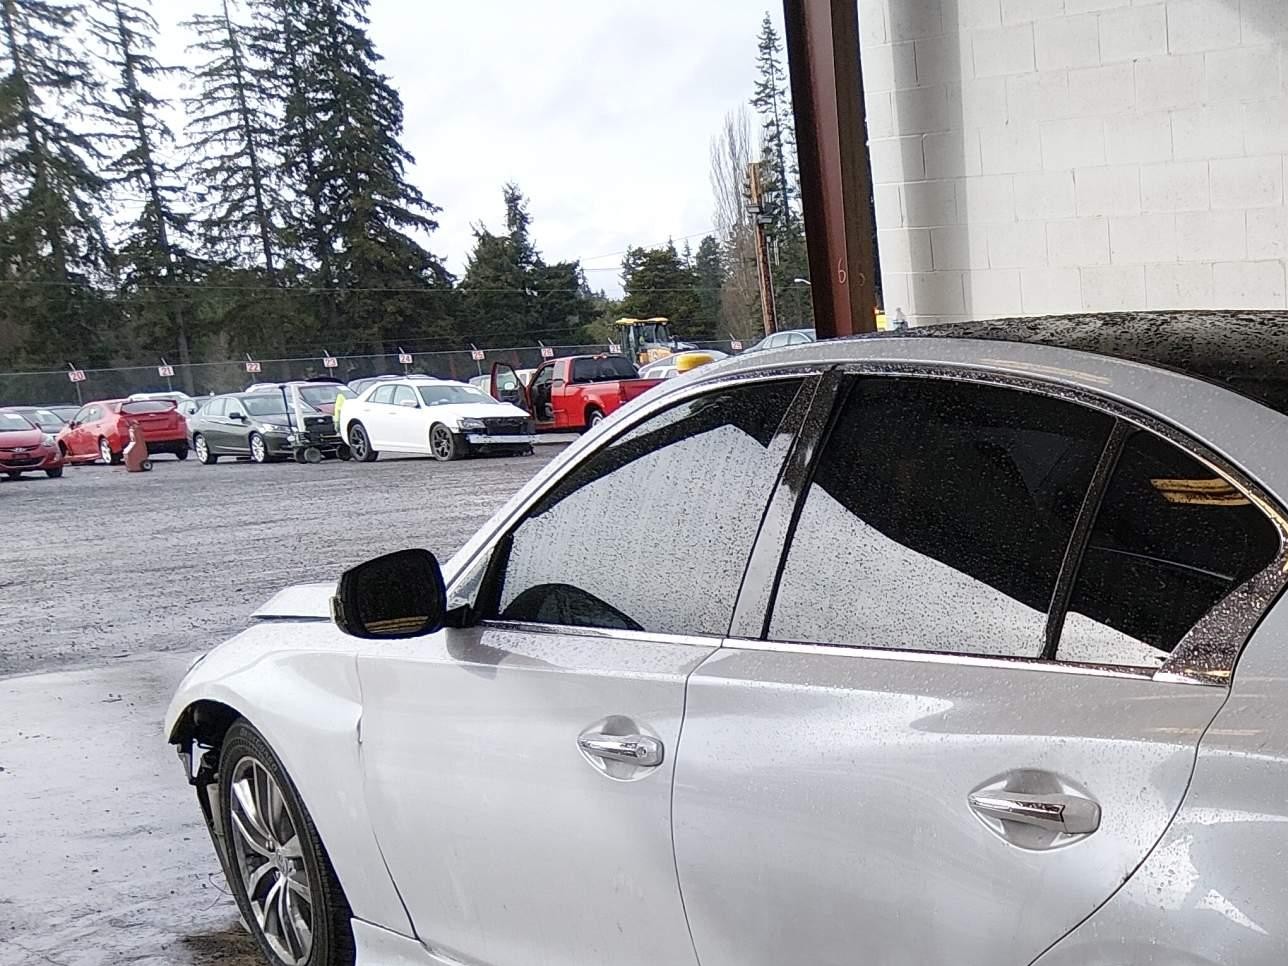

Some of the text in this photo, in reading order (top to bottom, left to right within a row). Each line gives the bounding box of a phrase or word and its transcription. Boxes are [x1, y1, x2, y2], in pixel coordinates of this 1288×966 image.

[400, 355, 411, 363] 24
[473, 351, 483, 359] 25
[326, 358, 336, 366] 23
[248, 363, 259, 371] 22
[161, 367, 171, 376] 21
[70, 371, 83, 381] 20
